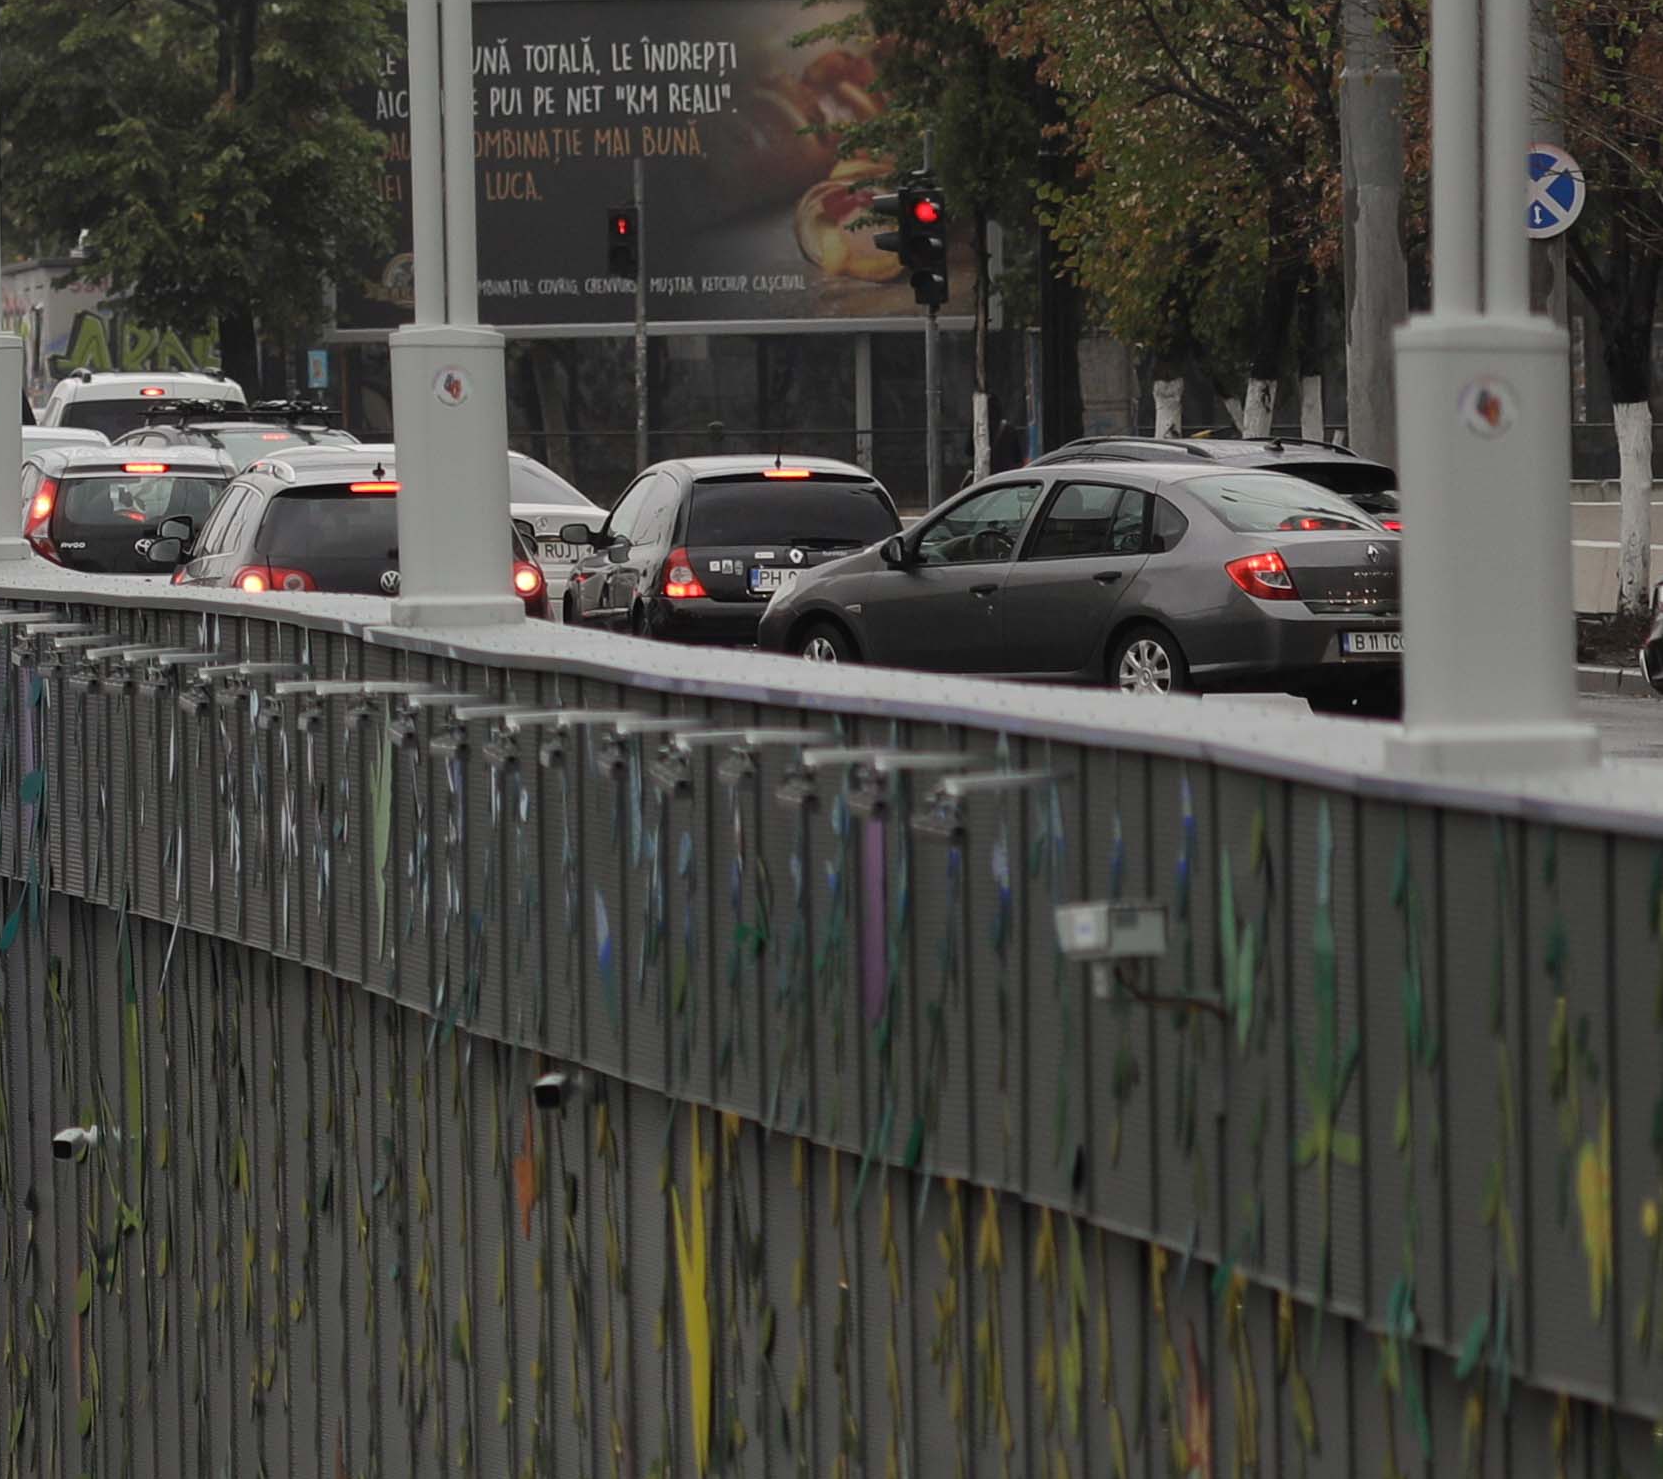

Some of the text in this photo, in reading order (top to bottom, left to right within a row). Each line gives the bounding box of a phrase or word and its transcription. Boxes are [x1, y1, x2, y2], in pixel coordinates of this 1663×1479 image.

[611, 42, 633, 72] LE
[640, 35, 737, 78] ÎNDREPȚI
[490, 86, 523, 116] PUI
[534, 85, 555, 116] PE
[567, 84, 605, 116] NET
[472, 126, 583, 164] OMBINAȚIE
[594, 126, 631, 157] MAI
[760, 570, 782, 587] PH
[1355, 634, 1365, 650] B
[1369, 634, 1378, 650] 11
